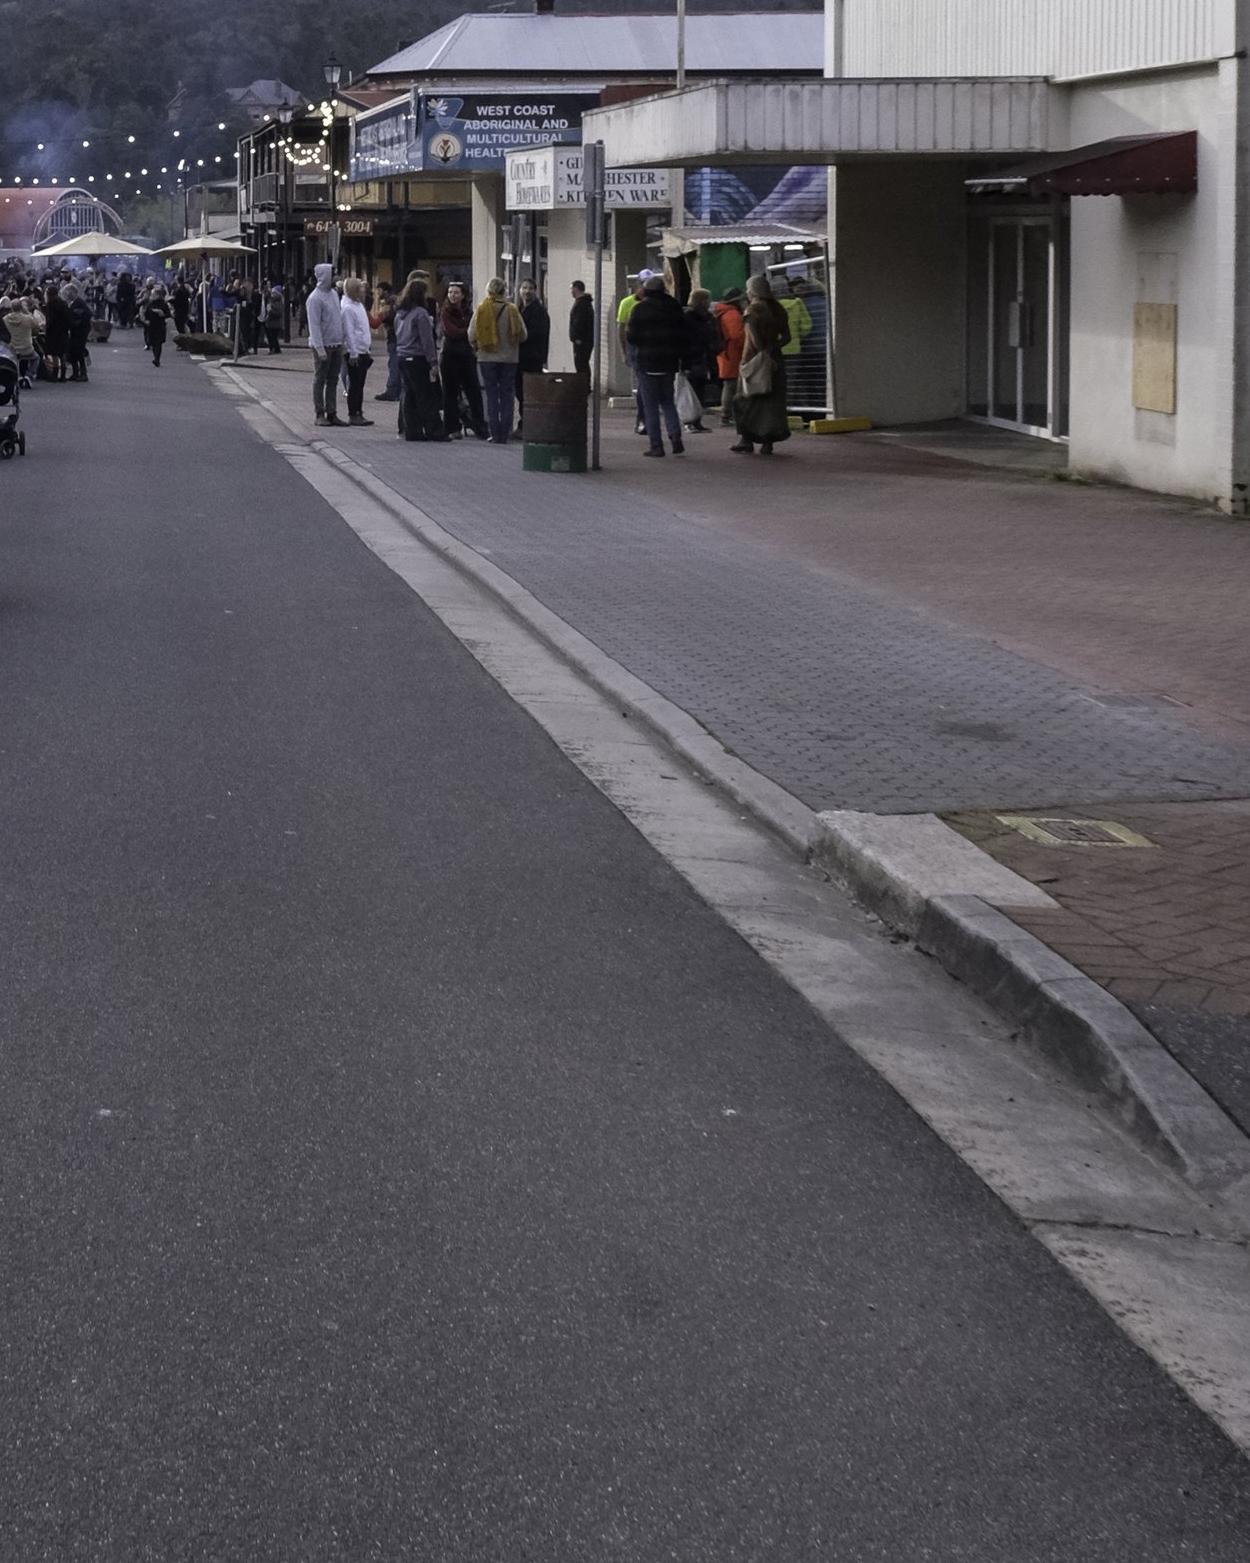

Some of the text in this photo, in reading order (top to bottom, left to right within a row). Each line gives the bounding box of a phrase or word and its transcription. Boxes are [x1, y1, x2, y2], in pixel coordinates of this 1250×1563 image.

[476, 105, 555, 116] WEST COAST
[463, 119, 568, 130] ABORIGINAL AND
[467, 133, 563, 144] MULTICULTURAL
[316, 220, 371, 232] 641 3004
